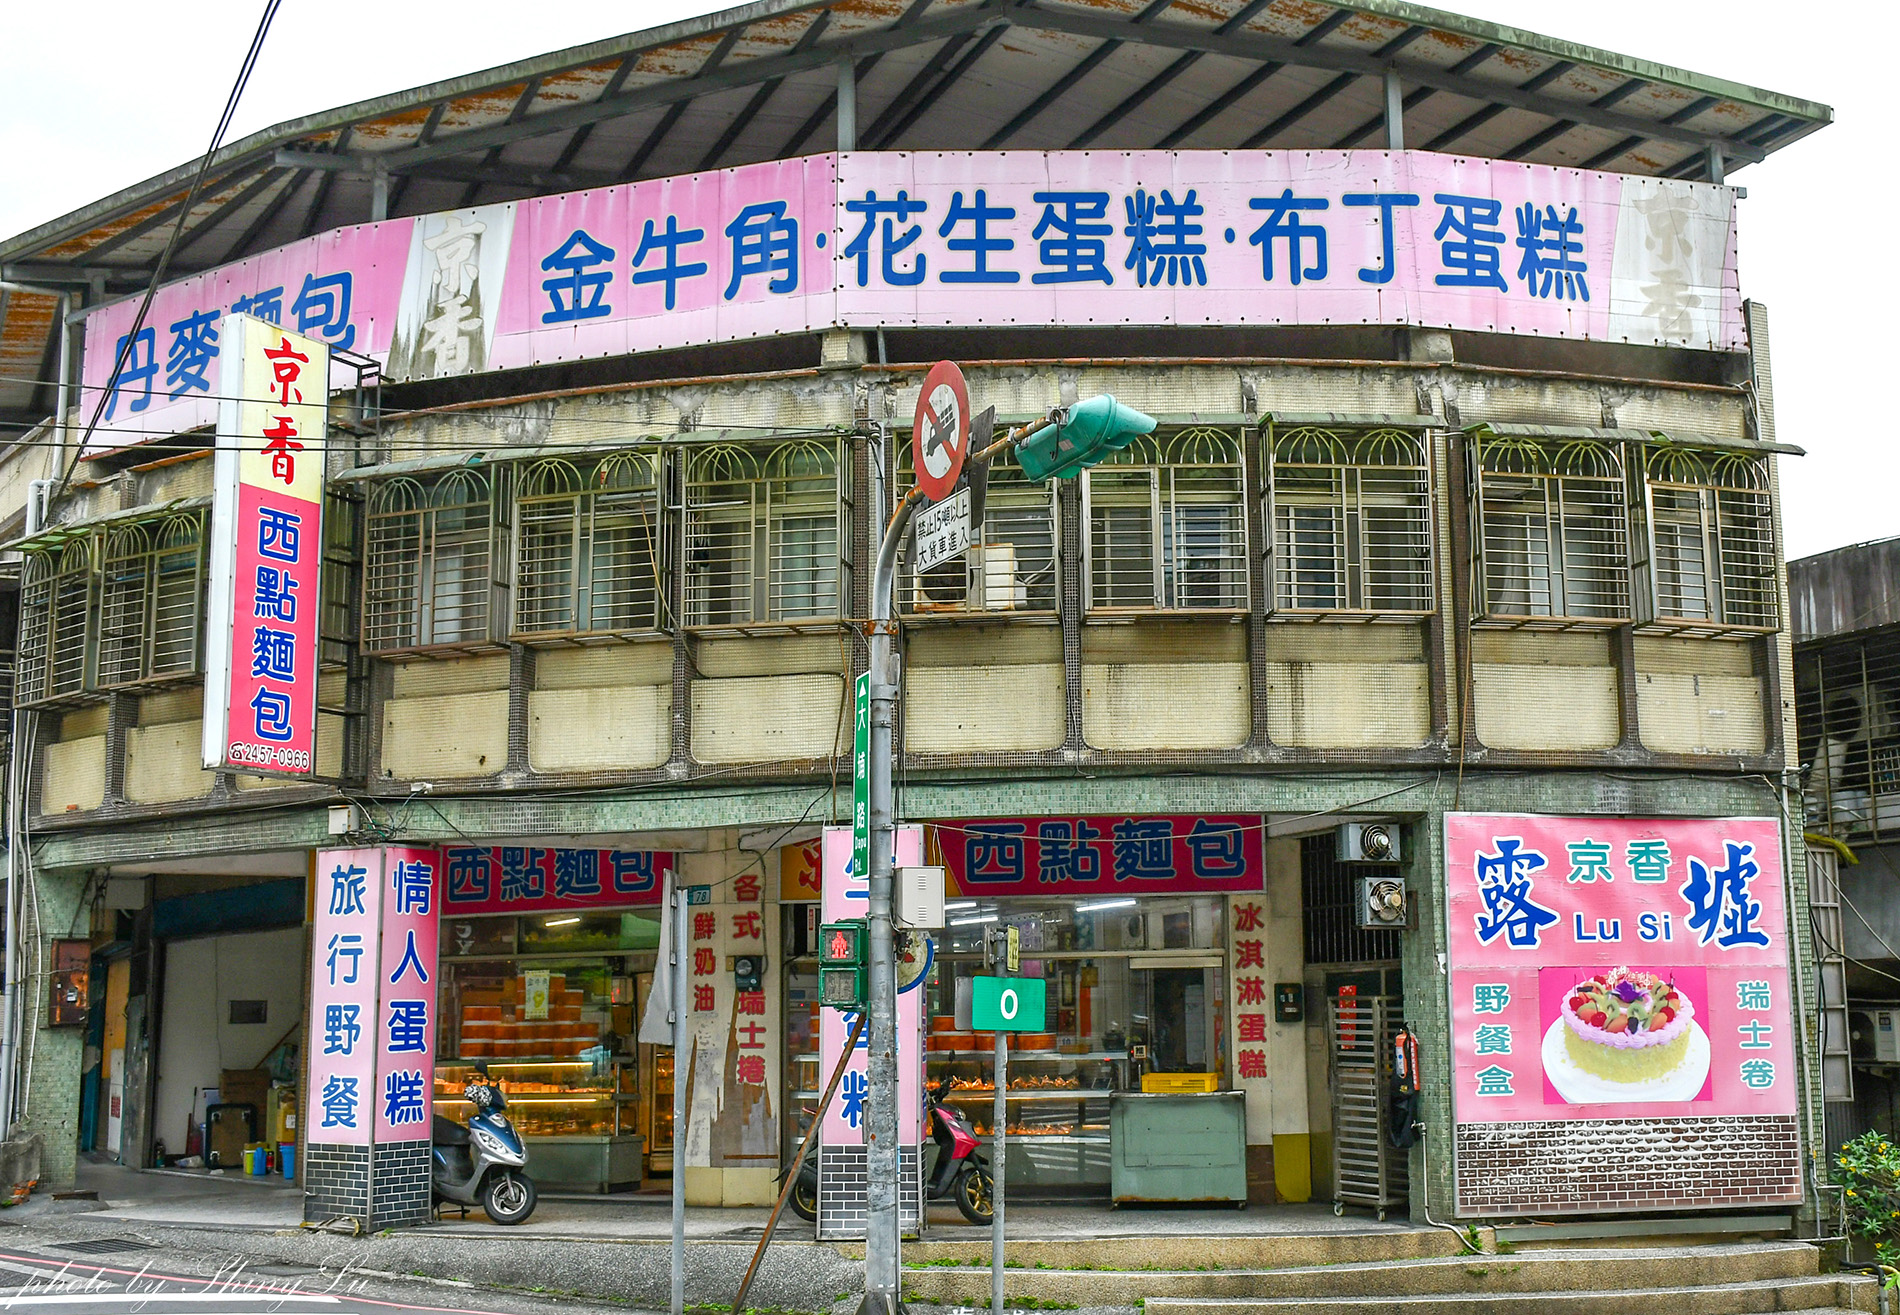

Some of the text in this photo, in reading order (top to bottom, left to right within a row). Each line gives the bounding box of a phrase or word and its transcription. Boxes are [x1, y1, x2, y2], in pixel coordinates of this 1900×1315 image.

[420, 216, 488, 372] 京香
[260, 336, 310, 486] 京香
[918, 526, 969, 567] 大貨車進入
[250, 506, 302, 741] 西點麵包
[244, 743, 309, 769] 2457-0966
[447, 846, 655, 902] 西點麵包
[854, 835, 867, 851] Dapu
[964, 818, 1247, 884] 西點麵包
[1476, 839, 1558, 947] 露
[1566, 839, 1672, 882] 京香
[696, 891, 707, 902] 78
[1575, 913, 1671, 941] Lu Si
[320, 863, 368, 1128] 旅行野餐
[383, 859, 433, 1126] 情人蛋糕
[693, 911, 716, 1013] 鮮奶油
[1000, 988, 1019, 1020] 0
[1233, 901, 1268, 1079] 冰淇淋蛋糕
[1474, 984, 1514, 1095] 野餐盒
[1737, 981, 1775, 1088] 瑞士卷
